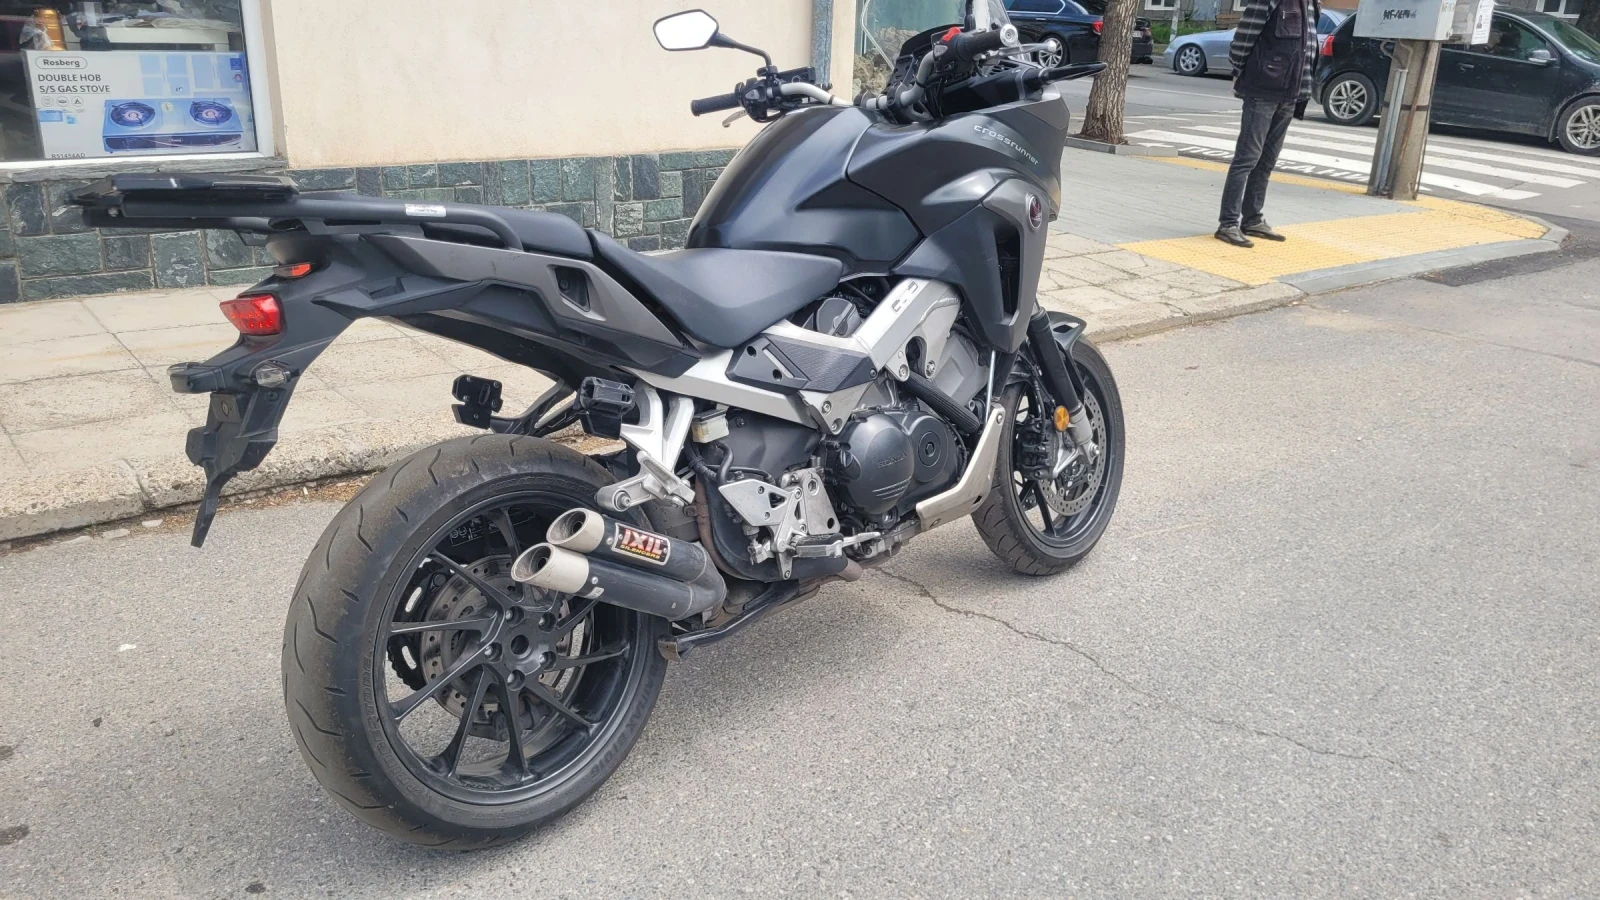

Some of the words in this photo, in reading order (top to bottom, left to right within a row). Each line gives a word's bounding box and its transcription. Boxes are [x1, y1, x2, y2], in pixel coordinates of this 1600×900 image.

[43, 59, 80, 67] Rosberg
[38, 74, 77, 82] DOUBLE
[80, 74, 102, 82] HOB
[39, 85, 56, 94] S/S
[57, 85, 78, 93] GAS
[80, 85, 111, 93] STOVE
[973, 124, 1039, 165] crossrunner
[622, 528, 662, 555] IXIL
